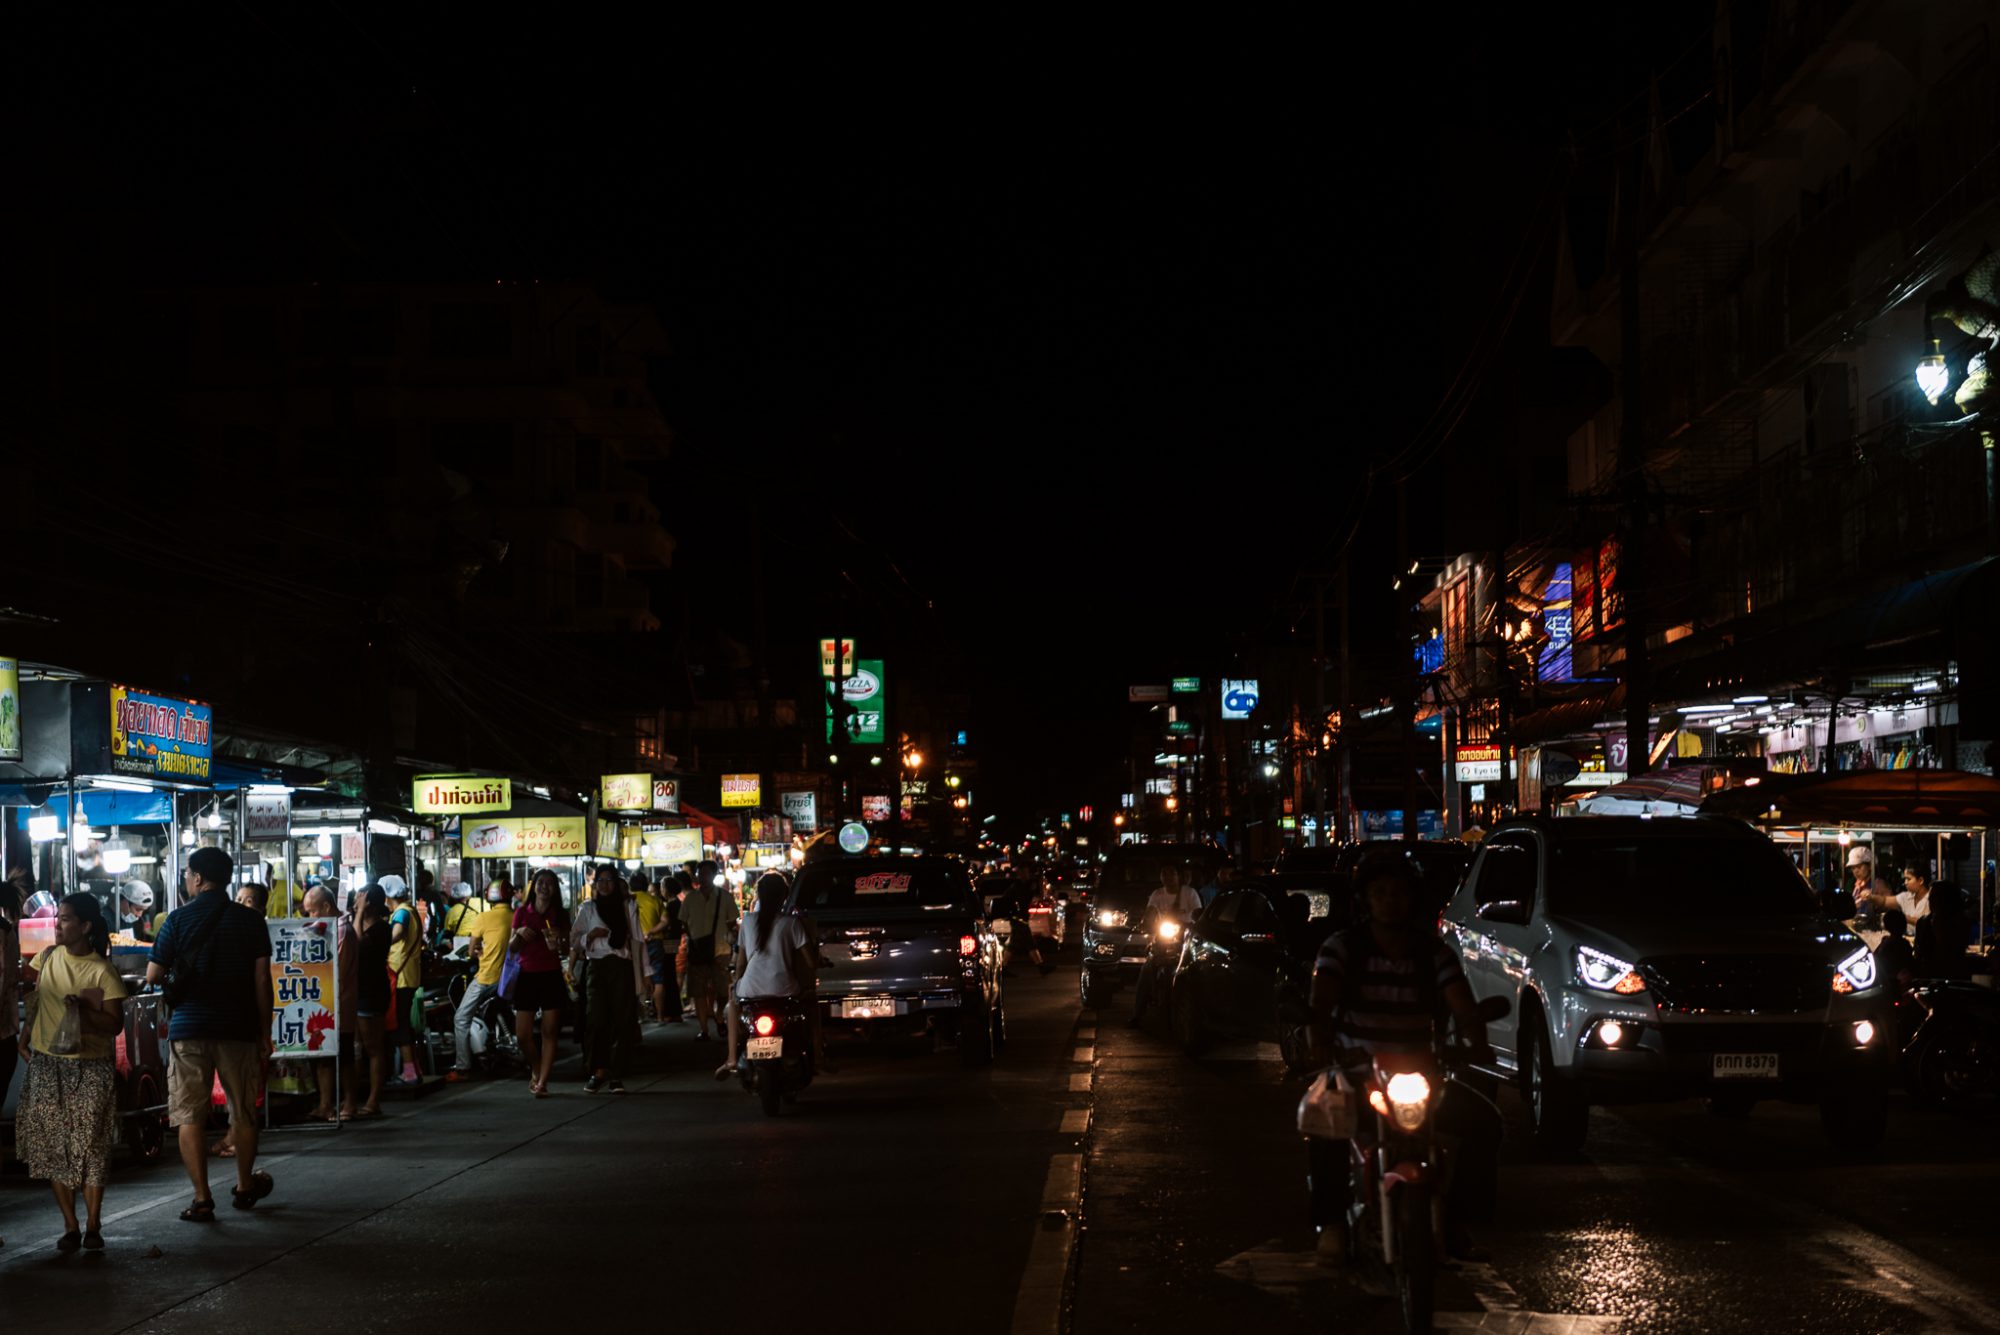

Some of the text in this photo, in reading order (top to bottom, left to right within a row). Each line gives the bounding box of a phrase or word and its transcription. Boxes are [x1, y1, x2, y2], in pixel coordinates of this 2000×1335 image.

[278, 965, 321, 1001] มัน
[272, 1007, 306, 1045] ไก่
[1716, 1055, 1776, 1068] 8กก 8379
